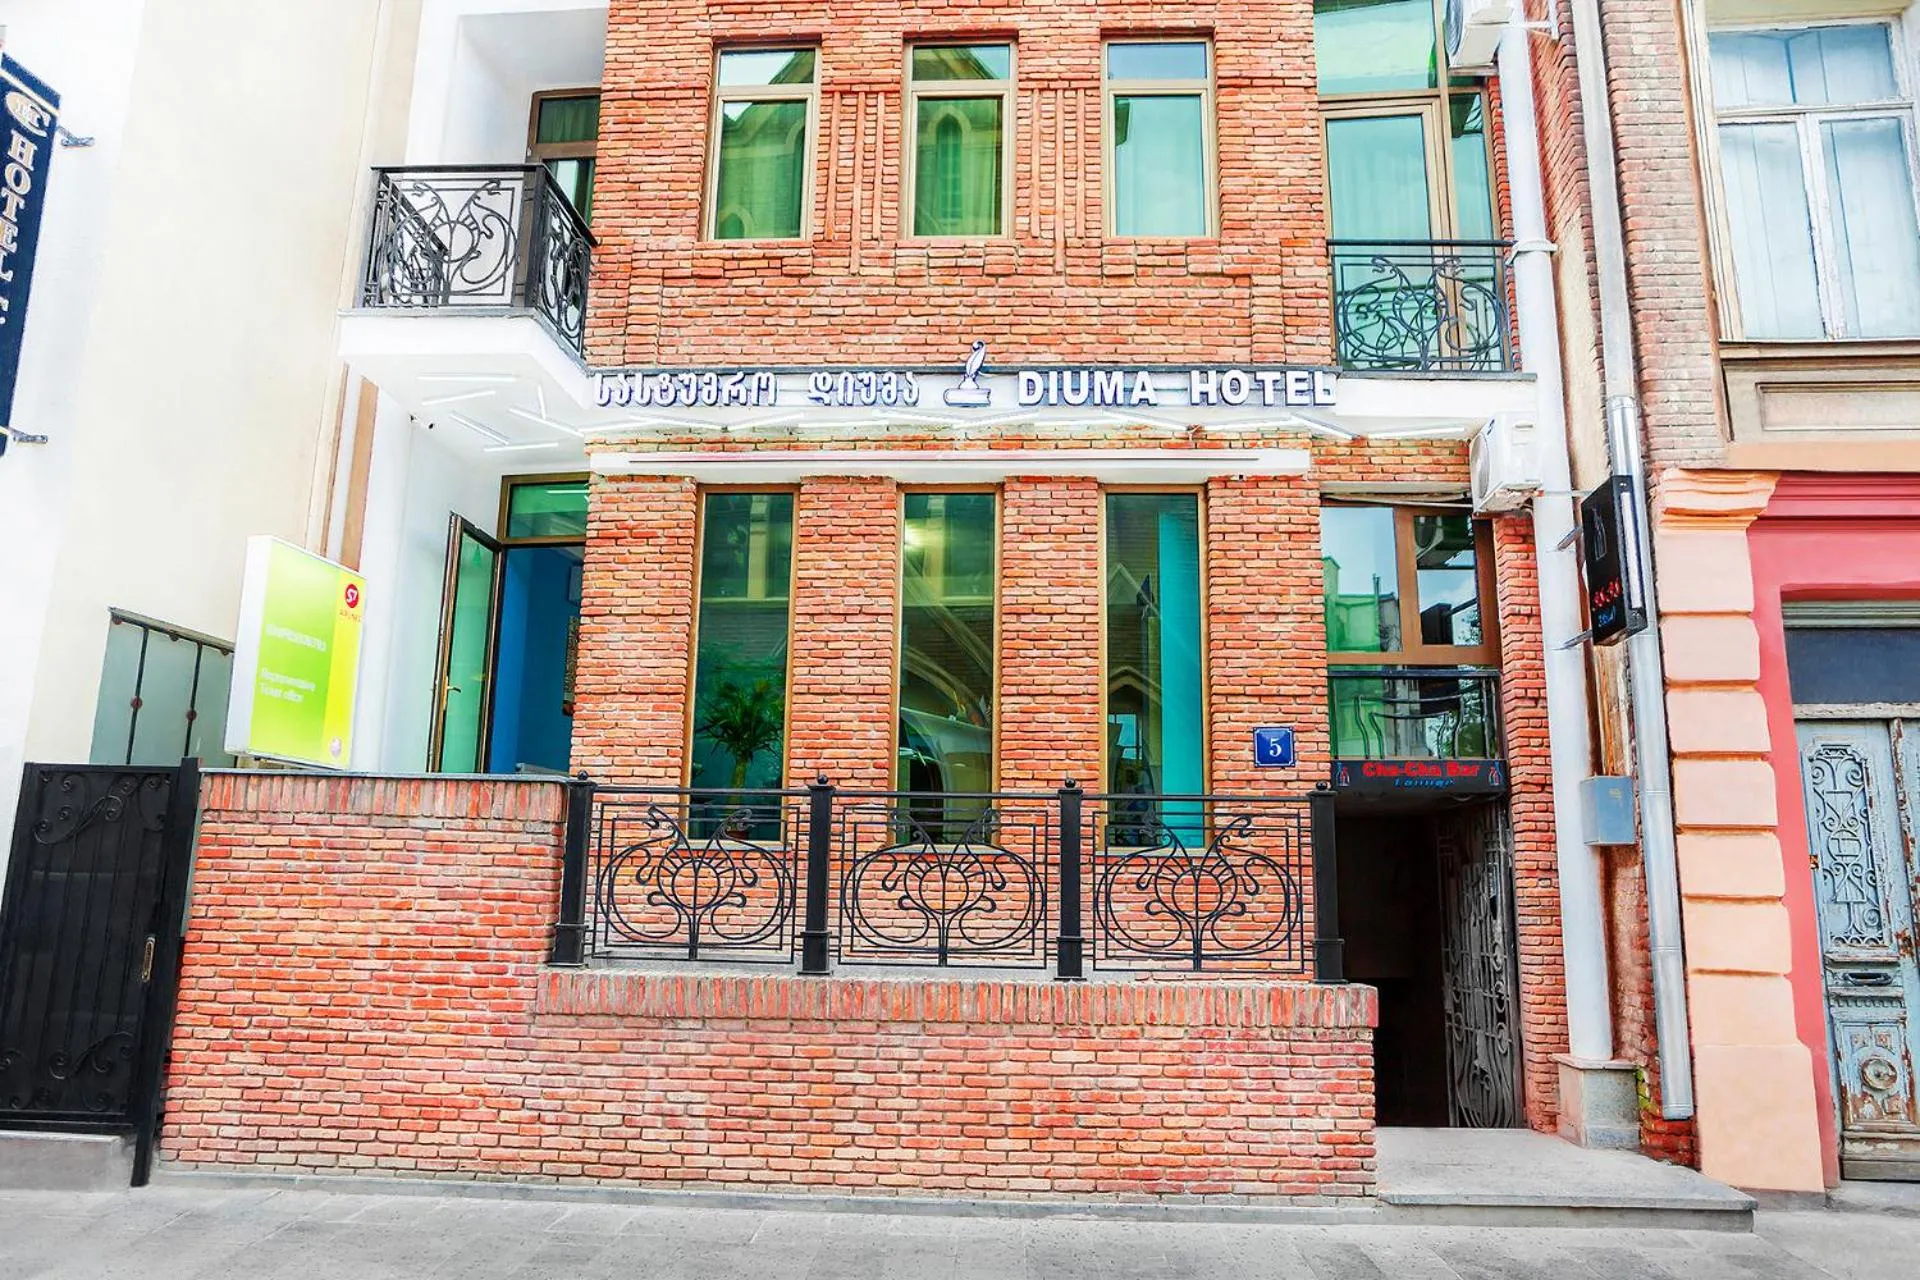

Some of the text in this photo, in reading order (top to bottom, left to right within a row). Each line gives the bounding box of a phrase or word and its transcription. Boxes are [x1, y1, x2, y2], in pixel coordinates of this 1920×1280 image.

[593, 370, 919, 406] სასტუმრო დიუმა
[1018, 368, 1337, 406] DIUMA HOTEL
[1269, 737, 1282, 757] 5
[1446, 761, 1480, 777] Bar
